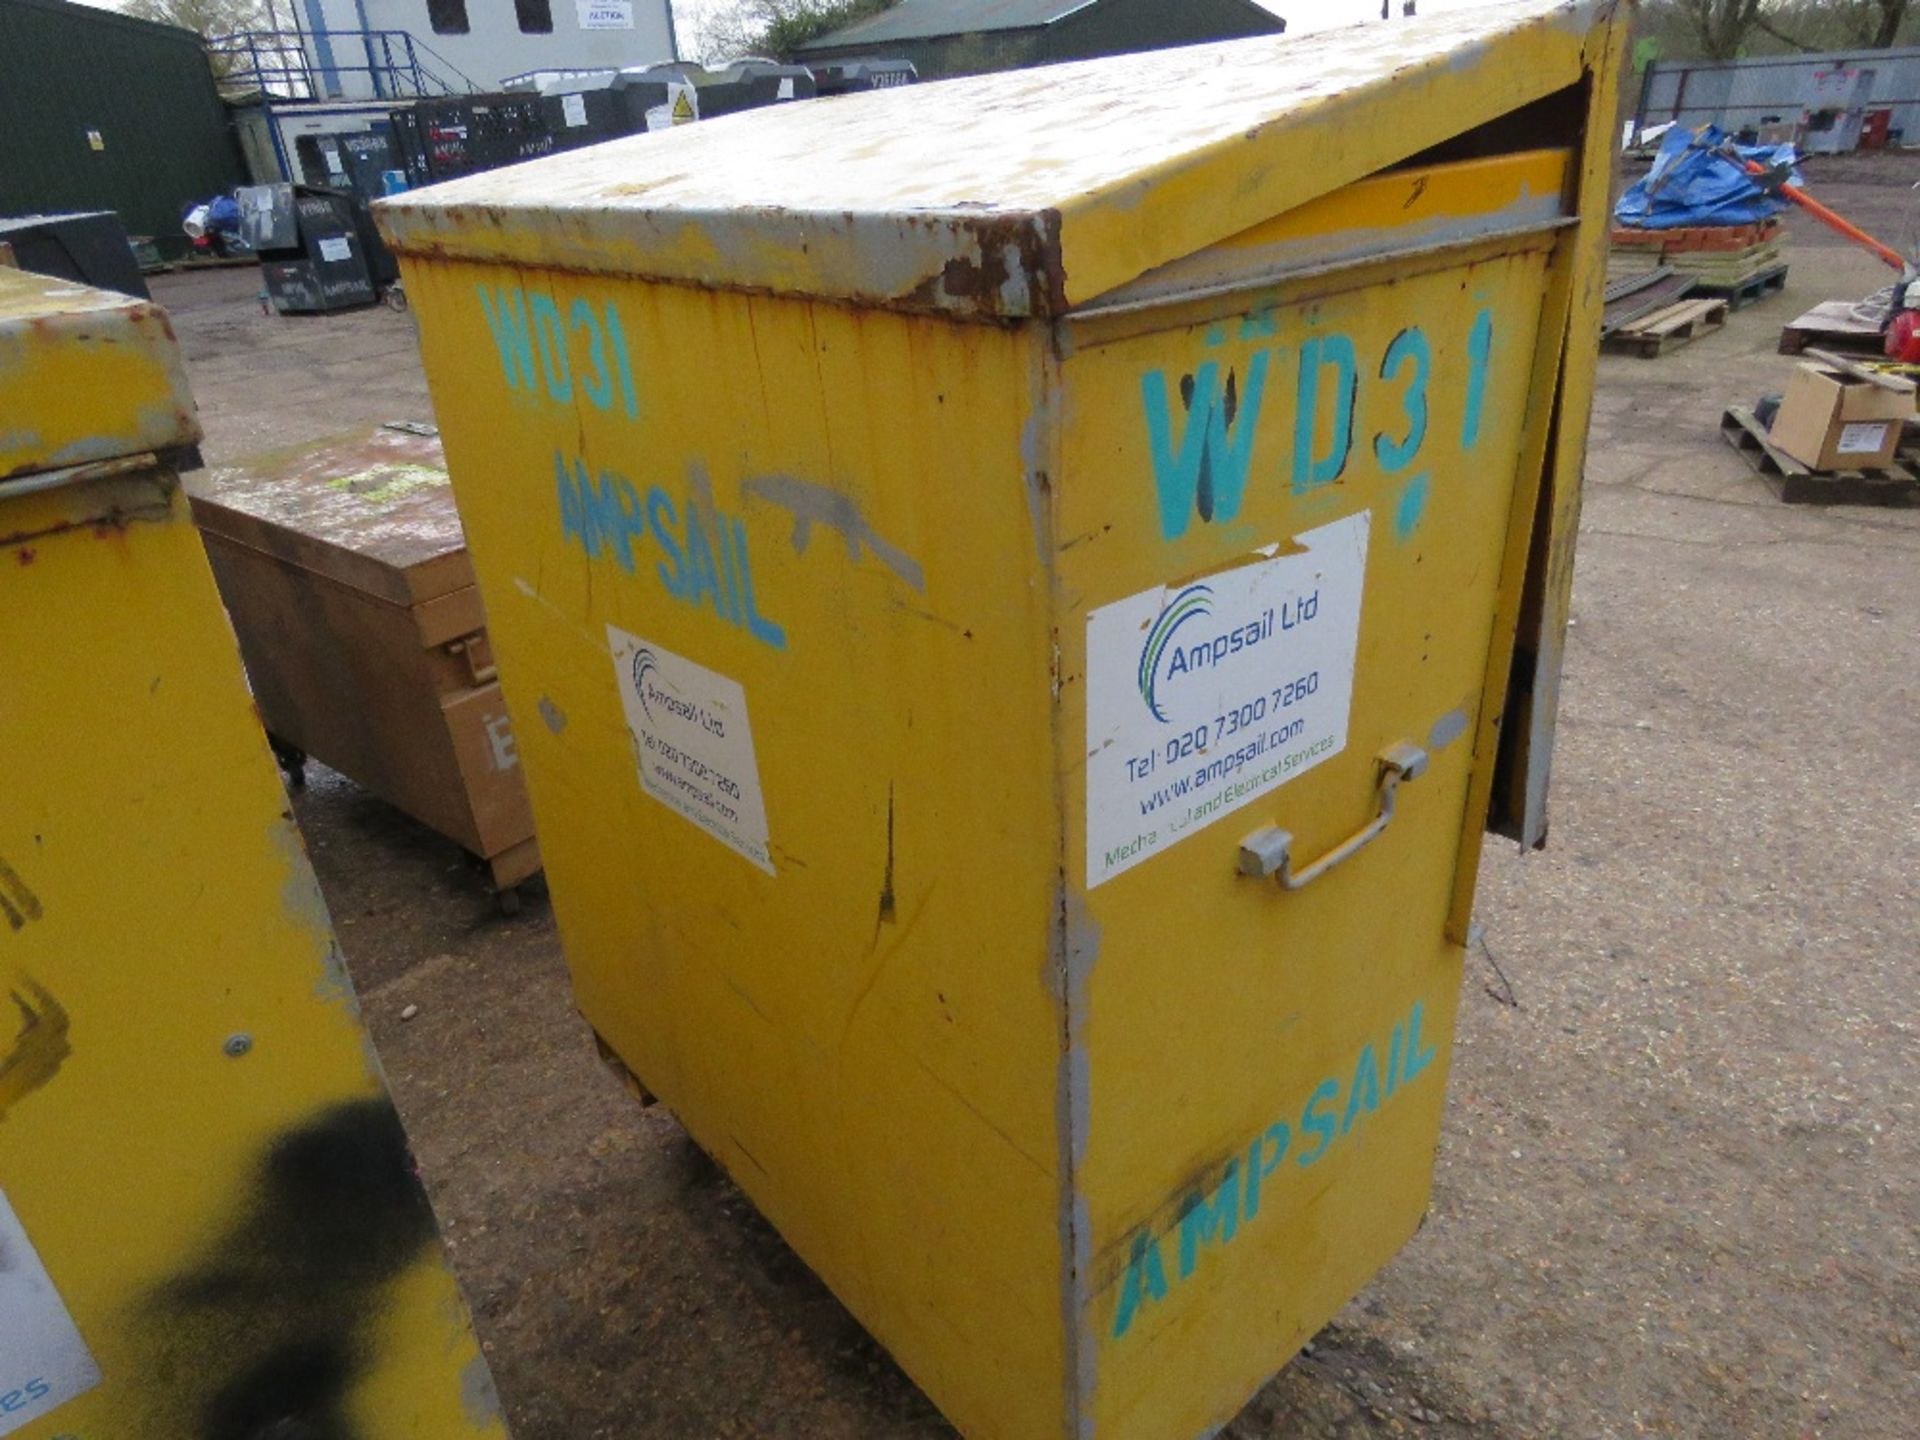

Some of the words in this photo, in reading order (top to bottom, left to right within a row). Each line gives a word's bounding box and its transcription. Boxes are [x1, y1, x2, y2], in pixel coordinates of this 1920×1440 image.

[476, 284, 638, 420] WD31
[555, 449, 787, 651] AMPSAIL
[1166, 607, 1273, 681] Ampsail
[1281, 590, 1319, 631] Ltd
[1140, 717, 1305, 815] www.ampsail.com
[1166, 725, 1208, 765] 020
[1213, 696, 1266, 745] 7300
[1272, 671, 1319, 716] 7260
[1192, 793, 1222, 821] and
[1283, 734, 1336, 771] Services
[1111, 998, 1438, 1341] AMPSAIL
